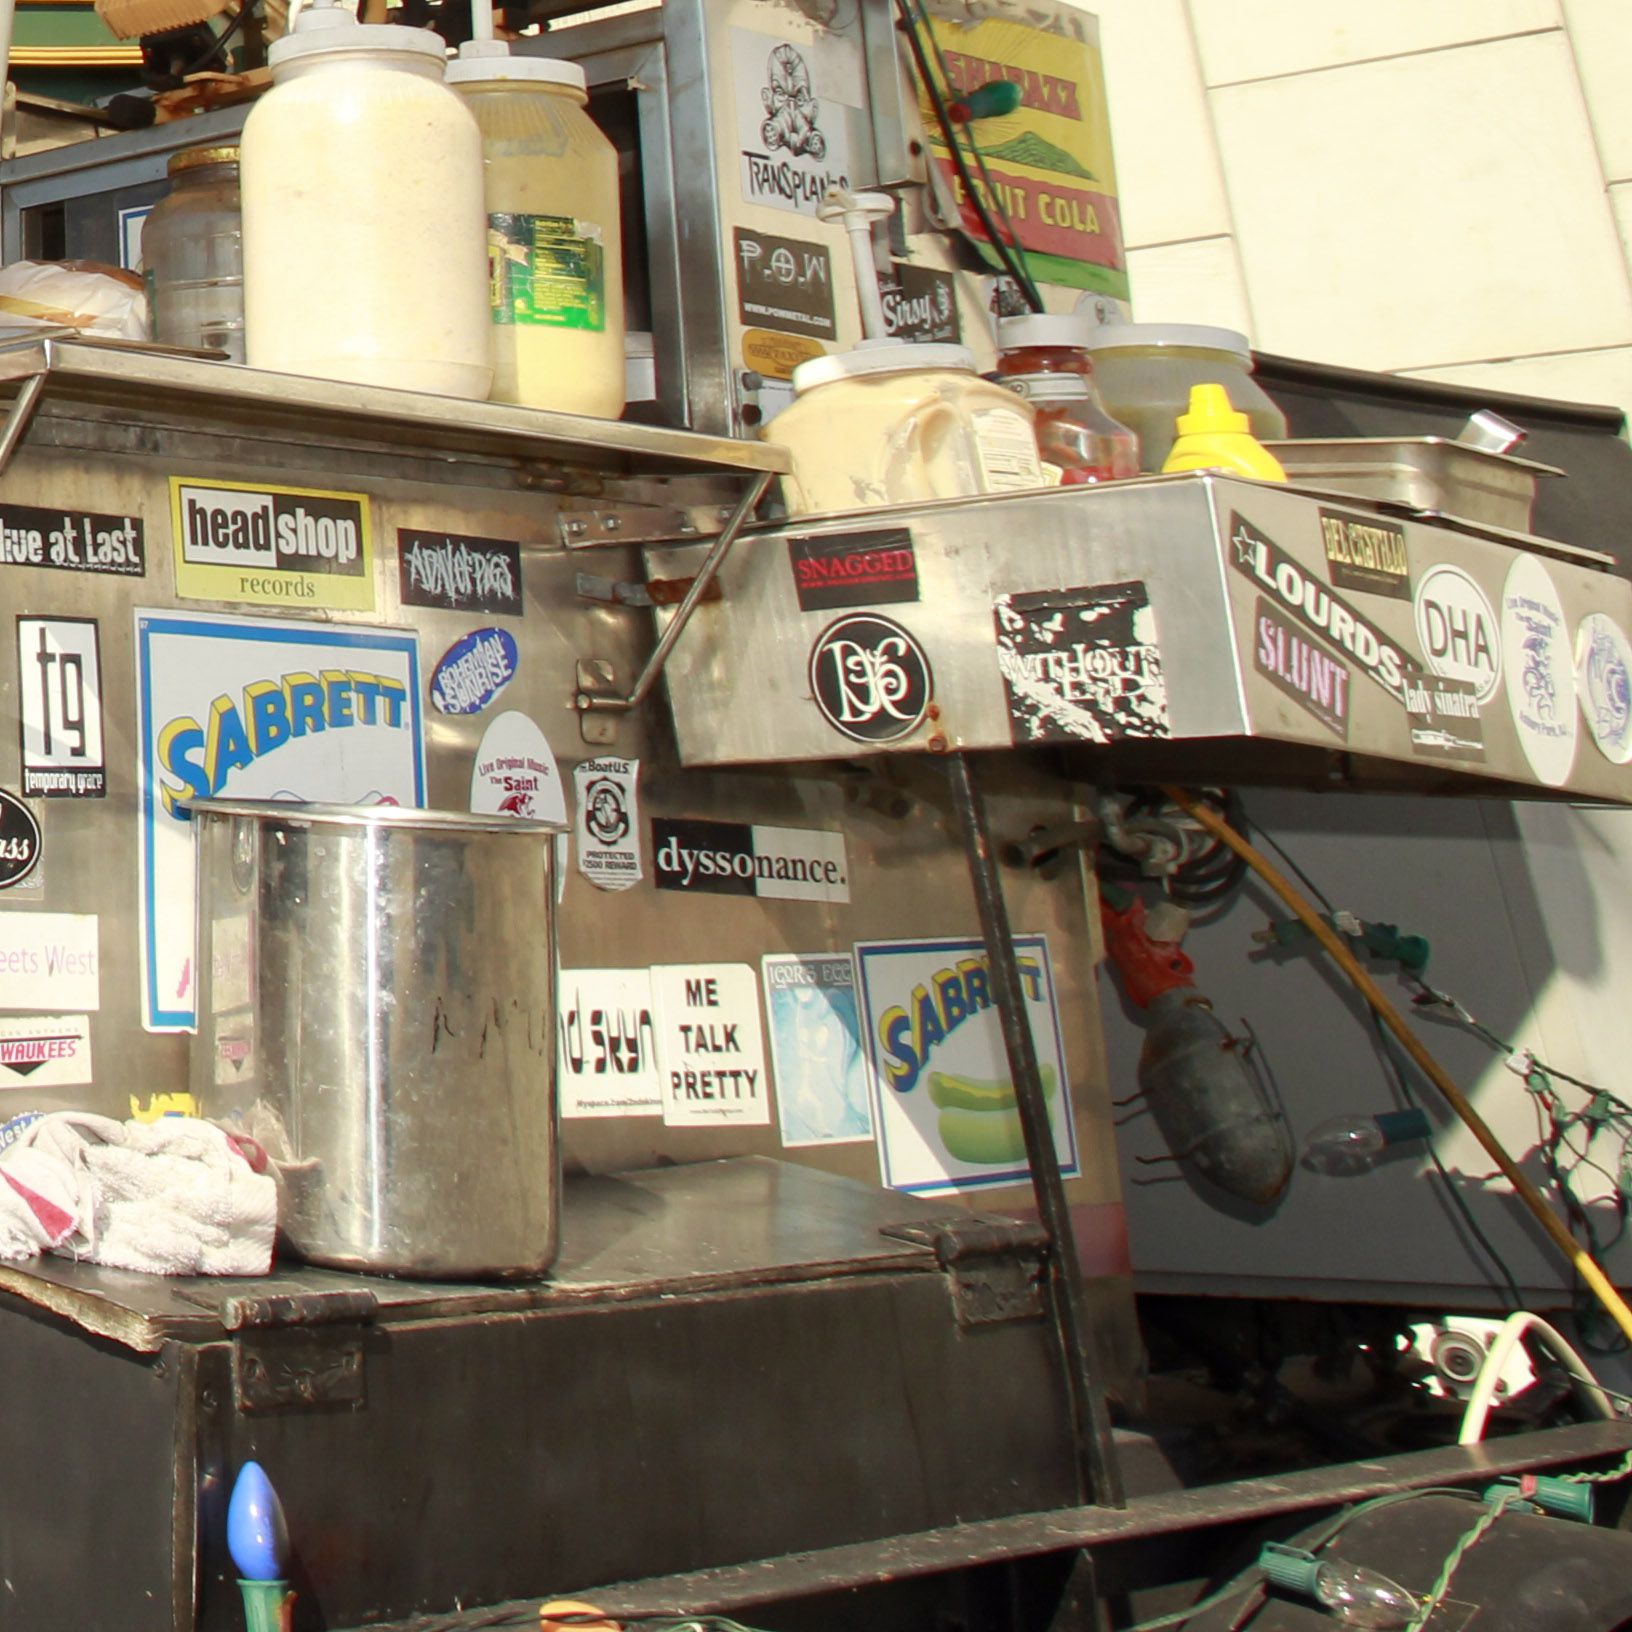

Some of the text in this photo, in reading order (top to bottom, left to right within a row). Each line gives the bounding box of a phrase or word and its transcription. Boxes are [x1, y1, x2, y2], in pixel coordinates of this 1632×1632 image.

[1038, 192, 1101, 235] COLA
[49, 516, 81, 566] at
[84, 517, 140, 565] Last
[186, 497, 359, 564] head shop
[797, 549, 914, 580] SNAGGED
[239, 574, 316, 599] records
[1253, 539, 1404, 688] LOURDS
[1423, 598, 1497, 674] DHA
[1000, 642, 1161, 684] WITHOUT
[156, 670, 407, 822] SABRETT
[24, 767, 103, 795] temporary grace
[503, 775, 539, 792] Saint
[656, 833, 848, 891] dyssonance.
[43, 944, 97, 977] West
[684, 978, 720, 1008] ME
[678, 1022, 741, 1055] TALK
[877, 954, 1043, 1094] SABRT
[670, 1068, 759, 1101] PRETTY
